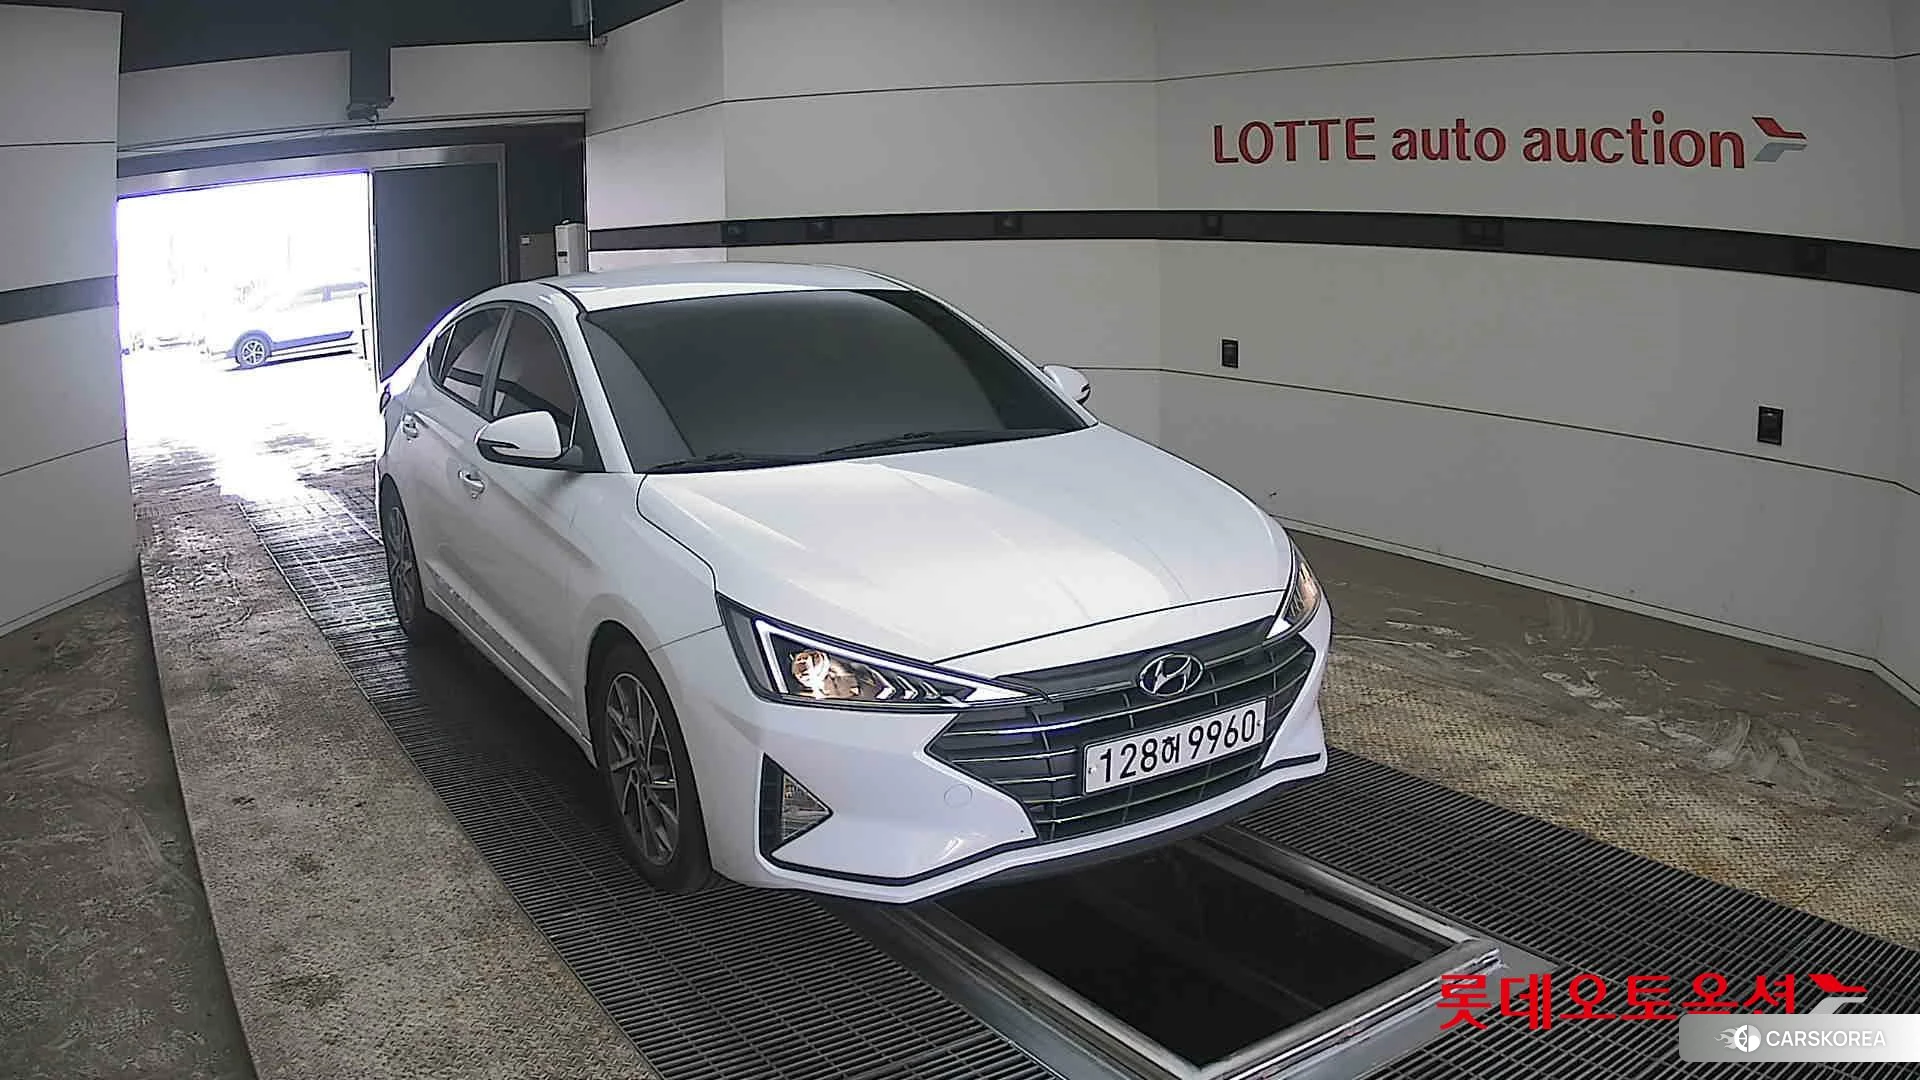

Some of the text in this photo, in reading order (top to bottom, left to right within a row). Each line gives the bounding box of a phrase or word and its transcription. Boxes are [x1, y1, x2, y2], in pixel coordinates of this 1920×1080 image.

[1213, 110, 1745, 168] LOTTE auto auction
